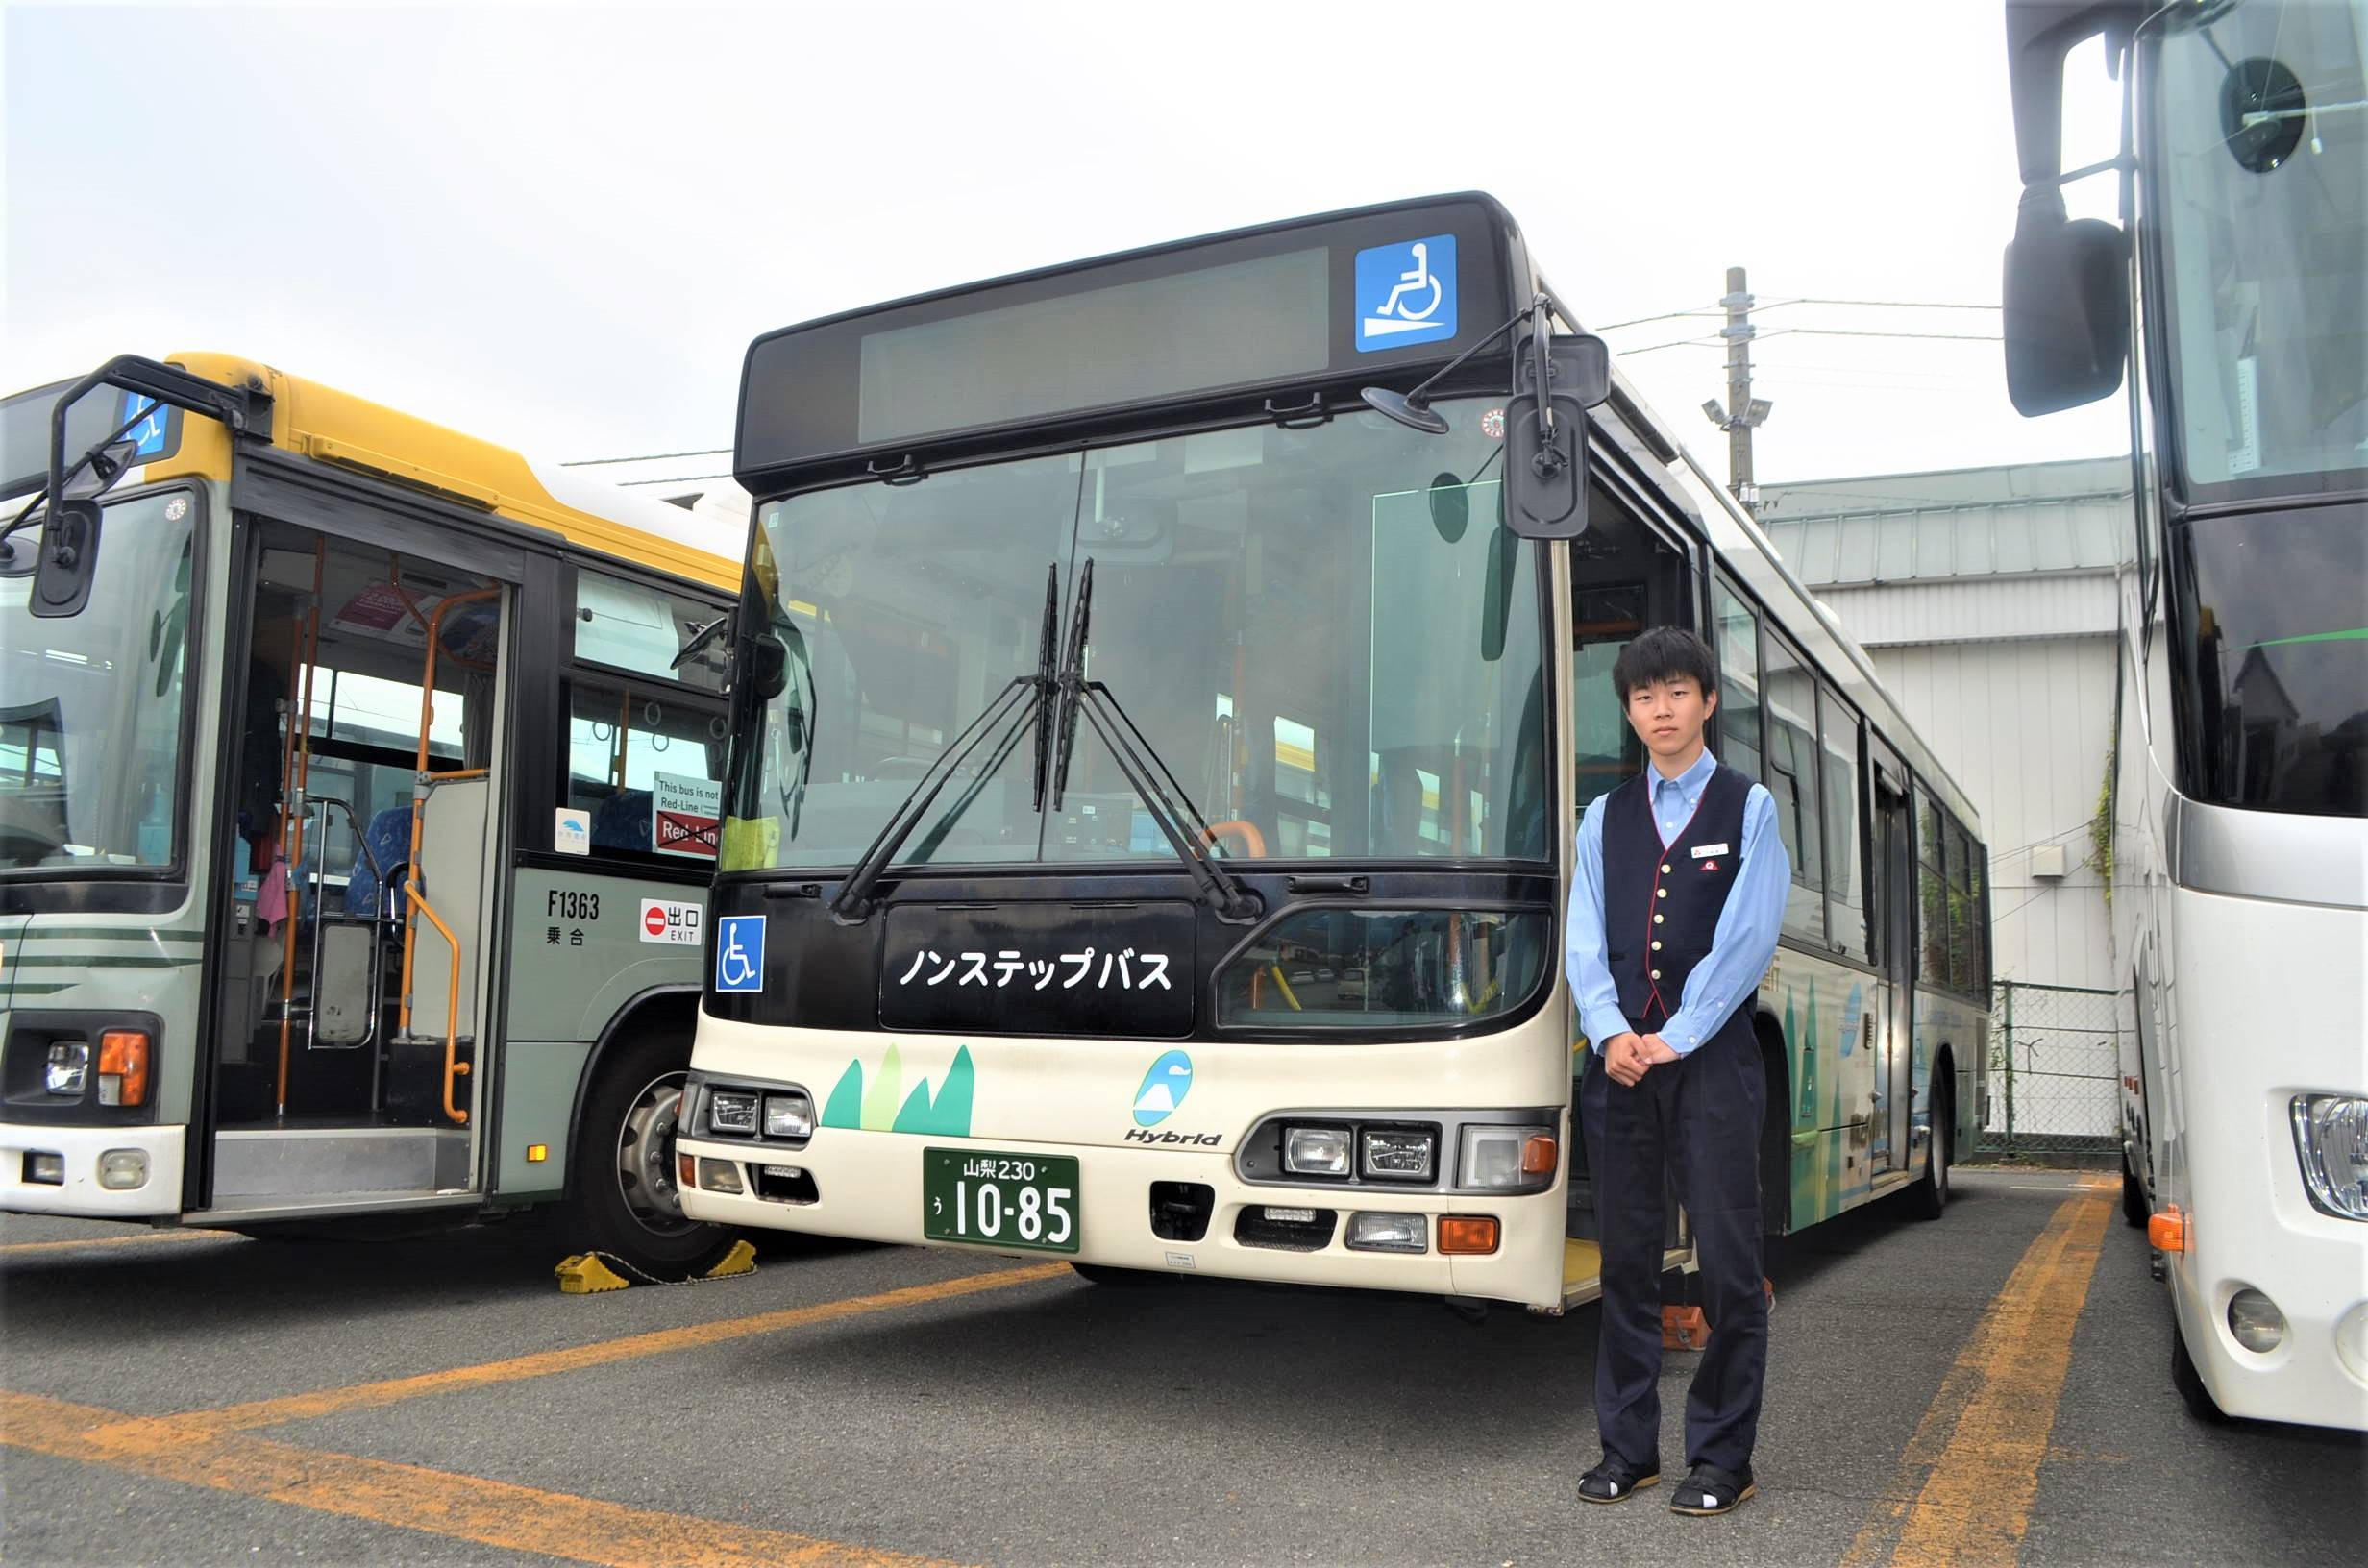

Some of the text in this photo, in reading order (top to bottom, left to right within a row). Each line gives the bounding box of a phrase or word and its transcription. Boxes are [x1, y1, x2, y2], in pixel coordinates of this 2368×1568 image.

[659, 781, 719, 800] This bus is not
[660, 796, 699, 813] Red-Line
[547, 890, 600, 920] F1363
[667, 906, 699, 928] 出口
[546, 926, 585, 946] 乗合
[670, 930, 694, 943] EXIT
[900, 946, 1172, 992] ノンステップバス
[1123, 1128, 1223, 1146] Hybrid
[933, 1181, 1072, 1243] う 10-85
